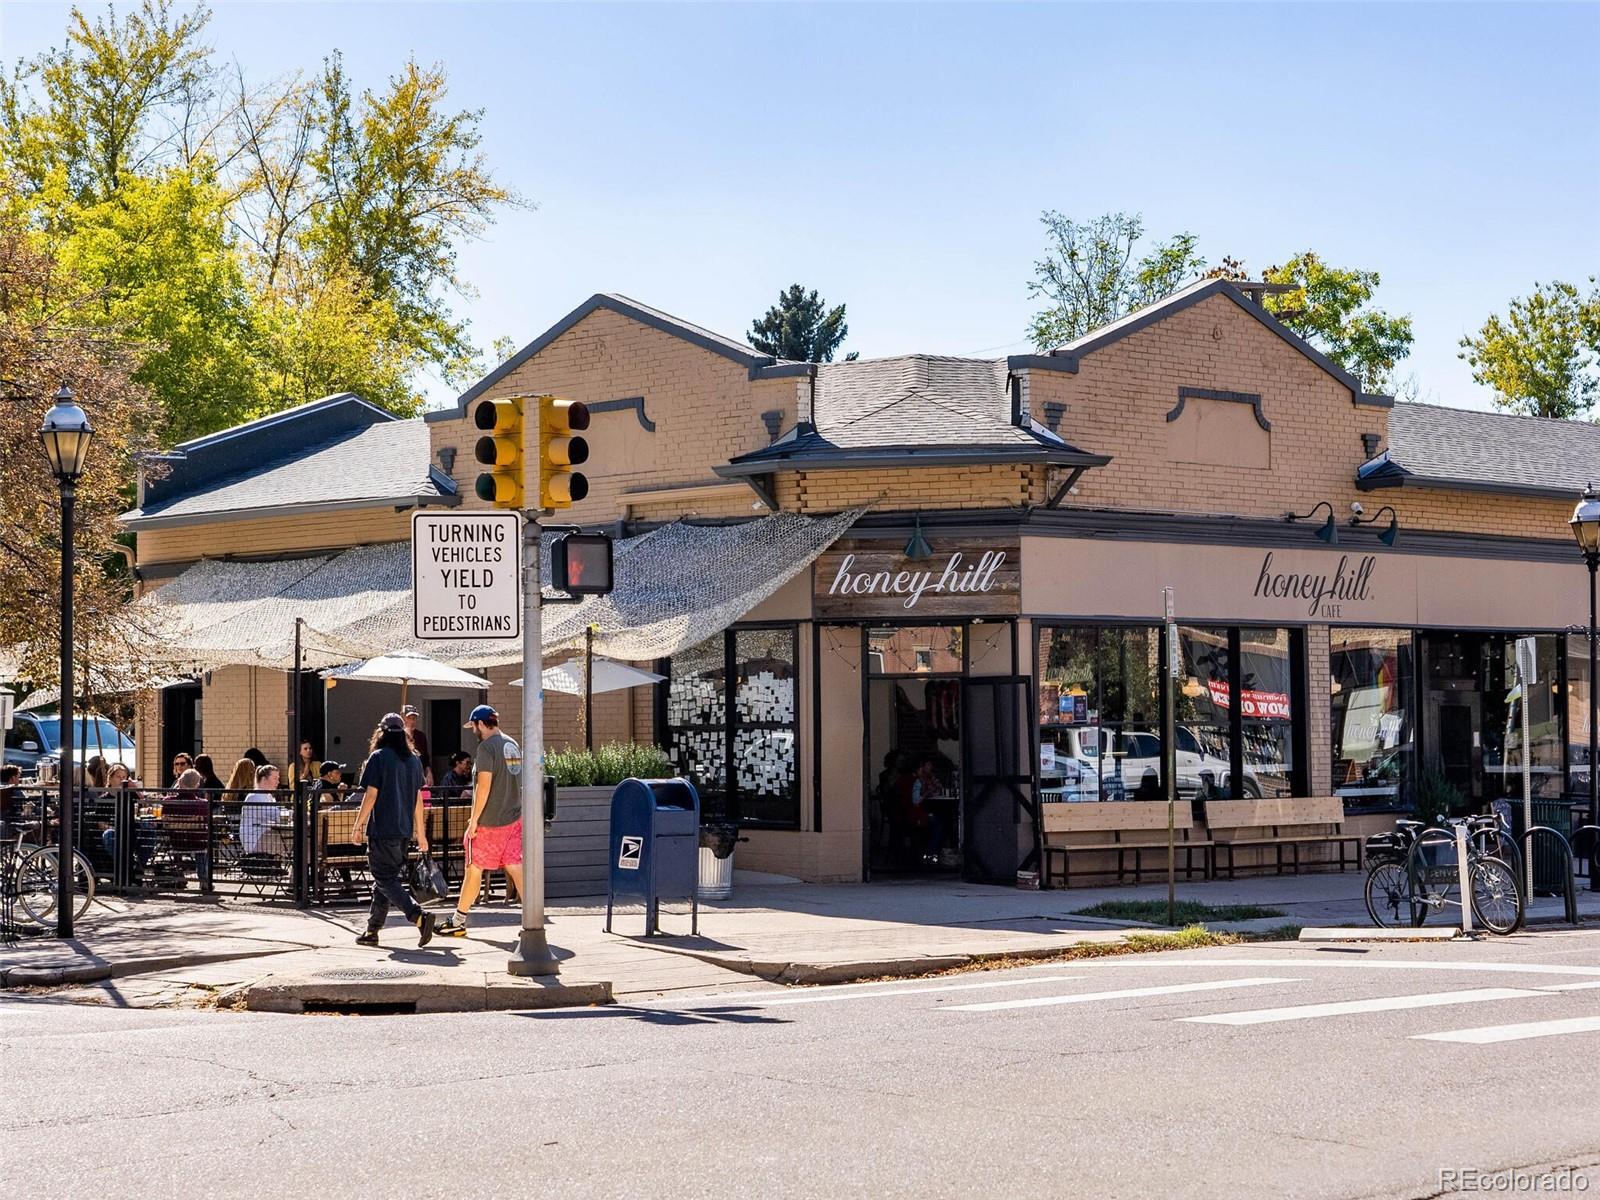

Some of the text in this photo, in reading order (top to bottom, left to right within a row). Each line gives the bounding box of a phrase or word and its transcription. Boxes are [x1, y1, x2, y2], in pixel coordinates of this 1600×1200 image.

[428, 524, 505, 543] TURNING
[431, 547, 502, 563] VEHICLES
[441, 569, 494, 588] YIELD
[829, 550, 1007, 609] honey hill
[1253, 551, 1377, 617] honey hill
[458, 594, 477, 610] TO
[1321, 604, 1343, 618] CAFE
[423, 615, 511, 632] PEDESTRIANS
